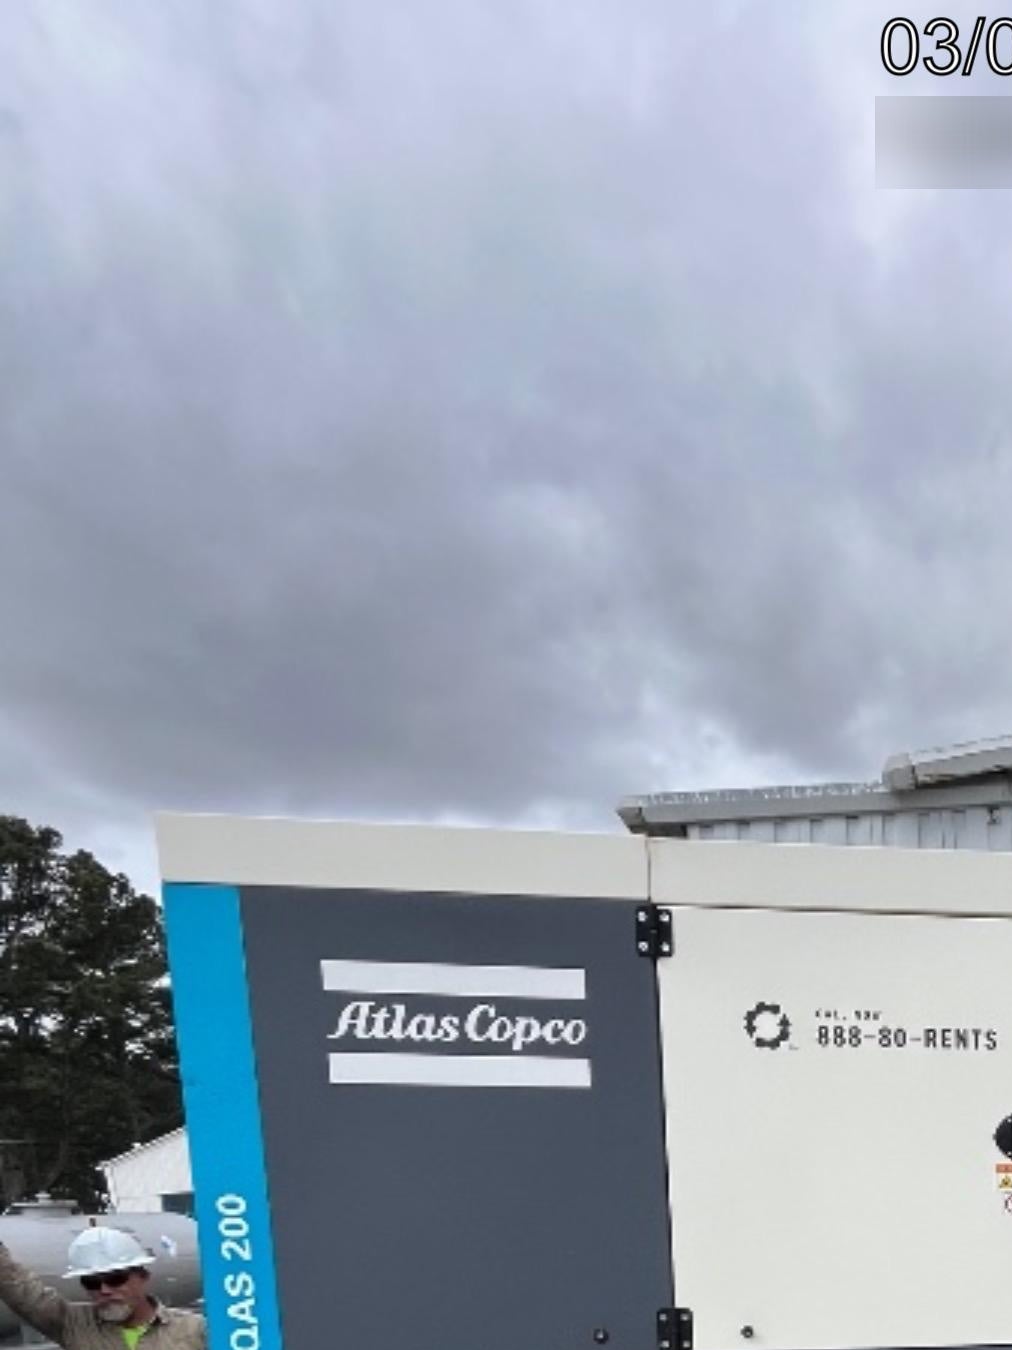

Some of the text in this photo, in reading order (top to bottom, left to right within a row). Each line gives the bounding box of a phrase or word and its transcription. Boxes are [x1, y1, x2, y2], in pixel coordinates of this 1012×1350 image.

[327, 1001, 587, 1051] Atlas Copco
[817, 1025, 998, 1051] 888-80-RENTS
[216, 1194, 252, 1261] 200
